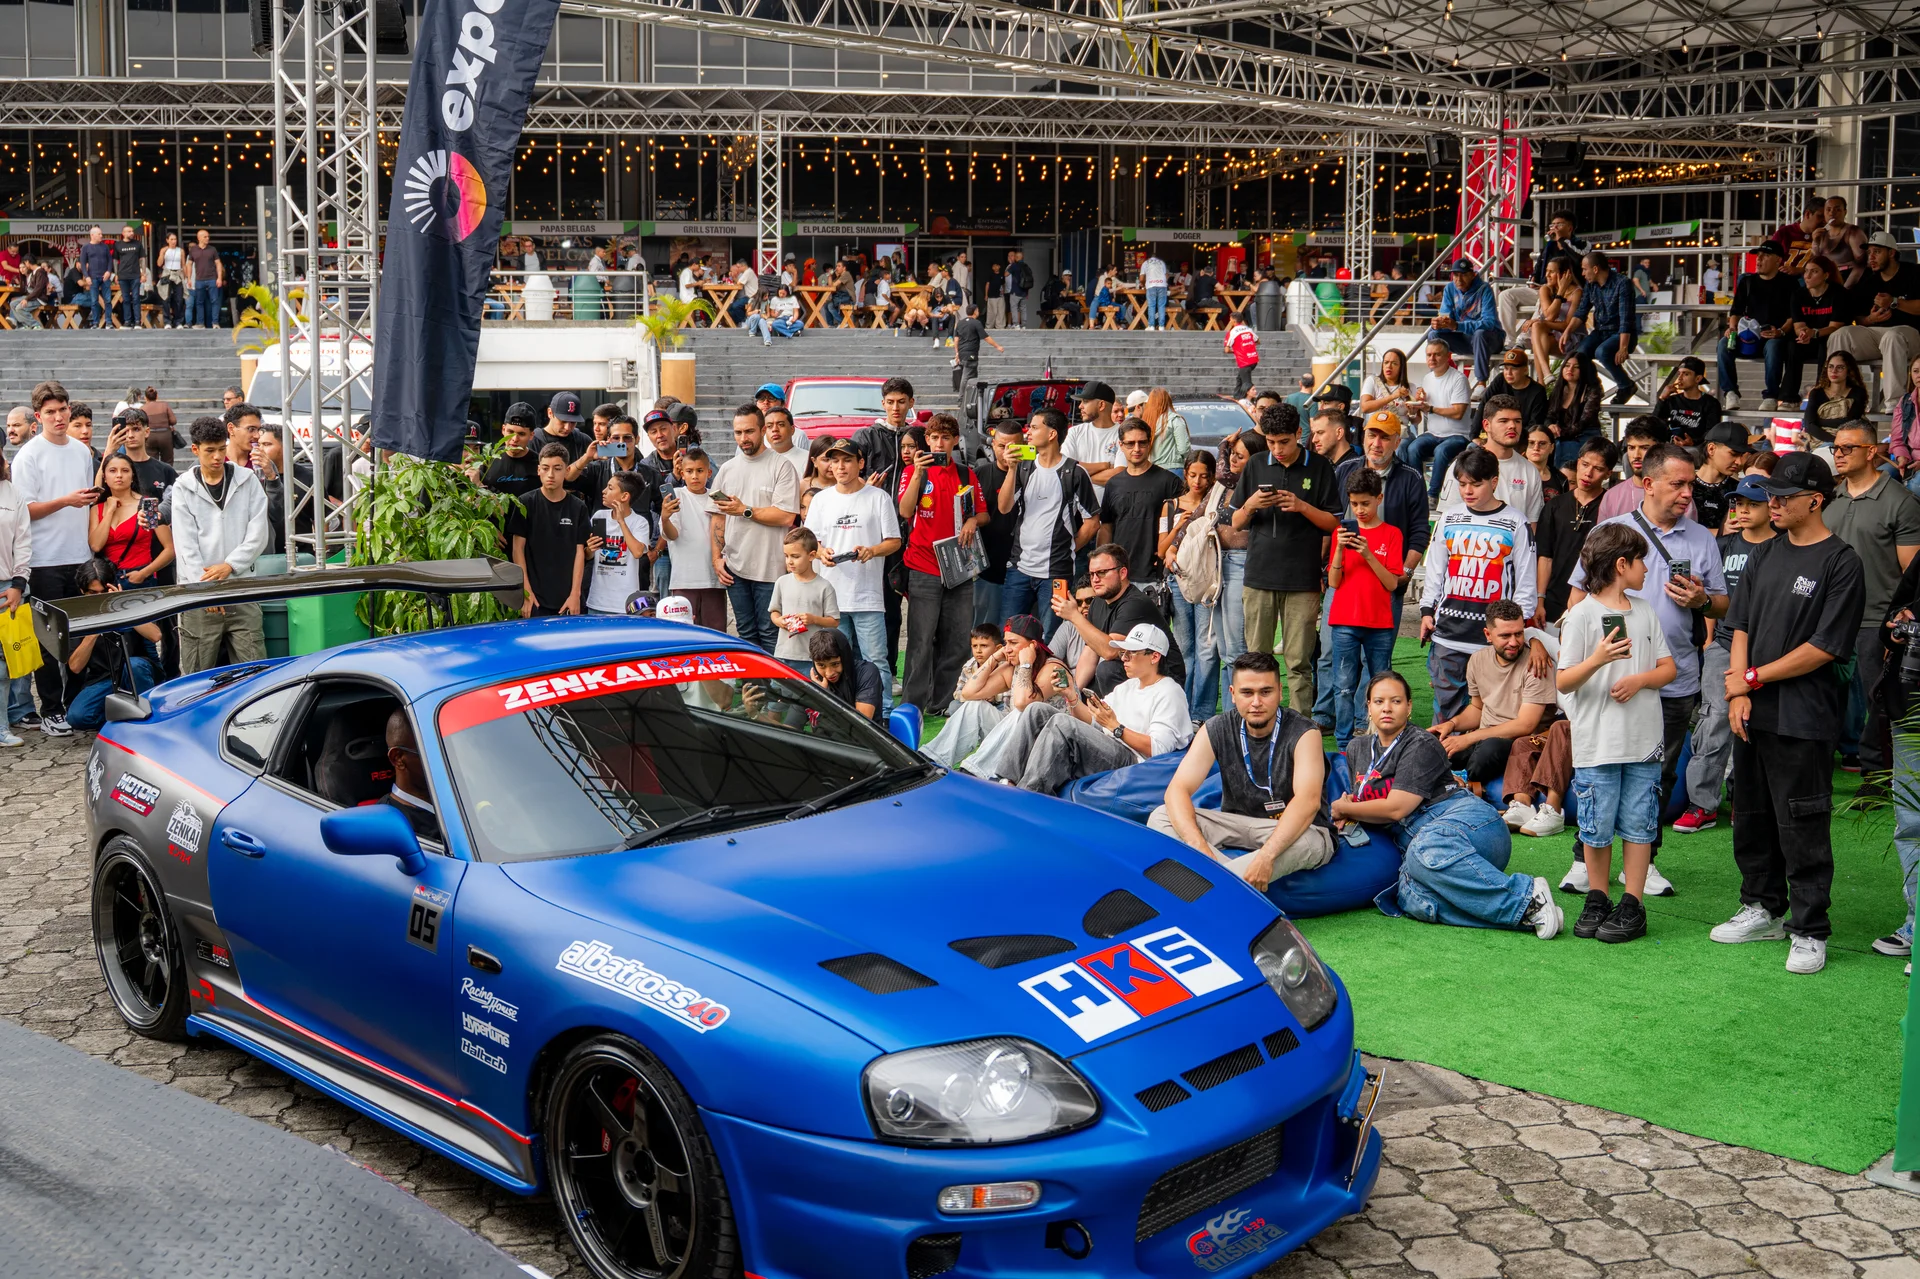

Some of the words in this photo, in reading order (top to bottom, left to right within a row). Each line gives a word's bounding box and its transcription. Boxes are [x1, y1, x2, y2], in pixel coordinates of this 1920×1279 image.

[37, 224, 65, 232] PIZZAS
[66, 224, 100, 232] PICCO
[540, 225, 566, 233] PAPAS
[567, 225, 596, 233] BELGAS
[683, 225, 704, 234] GRILL
[705, 225, 737, 234] STATION
[855, 226, 899, 234] SHAWARMA
[1173, 232, 1201, 240] DOGGER
[1314, 235, 1323, 244] AL
[1324, 235, 1350, 244] PASTO
[1451, 530, 1504, 559] KISS
[1457, 556, 1492, 579] MY
[1443, 576, 1500, 600] WRAP
[498, 663, 659, 710] ZENKAI
[657, 663, 747, 680] APPAREL
[116, 773, 161, 806] MOTOR
[168, 817, 201, 846] ZENKAI
[410, 903, 438, 945] 05
[1028, 931, 1216, 1022] HKS
[461, 977, 494, 1006] Racing
[488, 999, 519, 1020] House
[461, 1012, 510, 1049] Hypertune
[461, 1037, 508, 1075] Haltech
